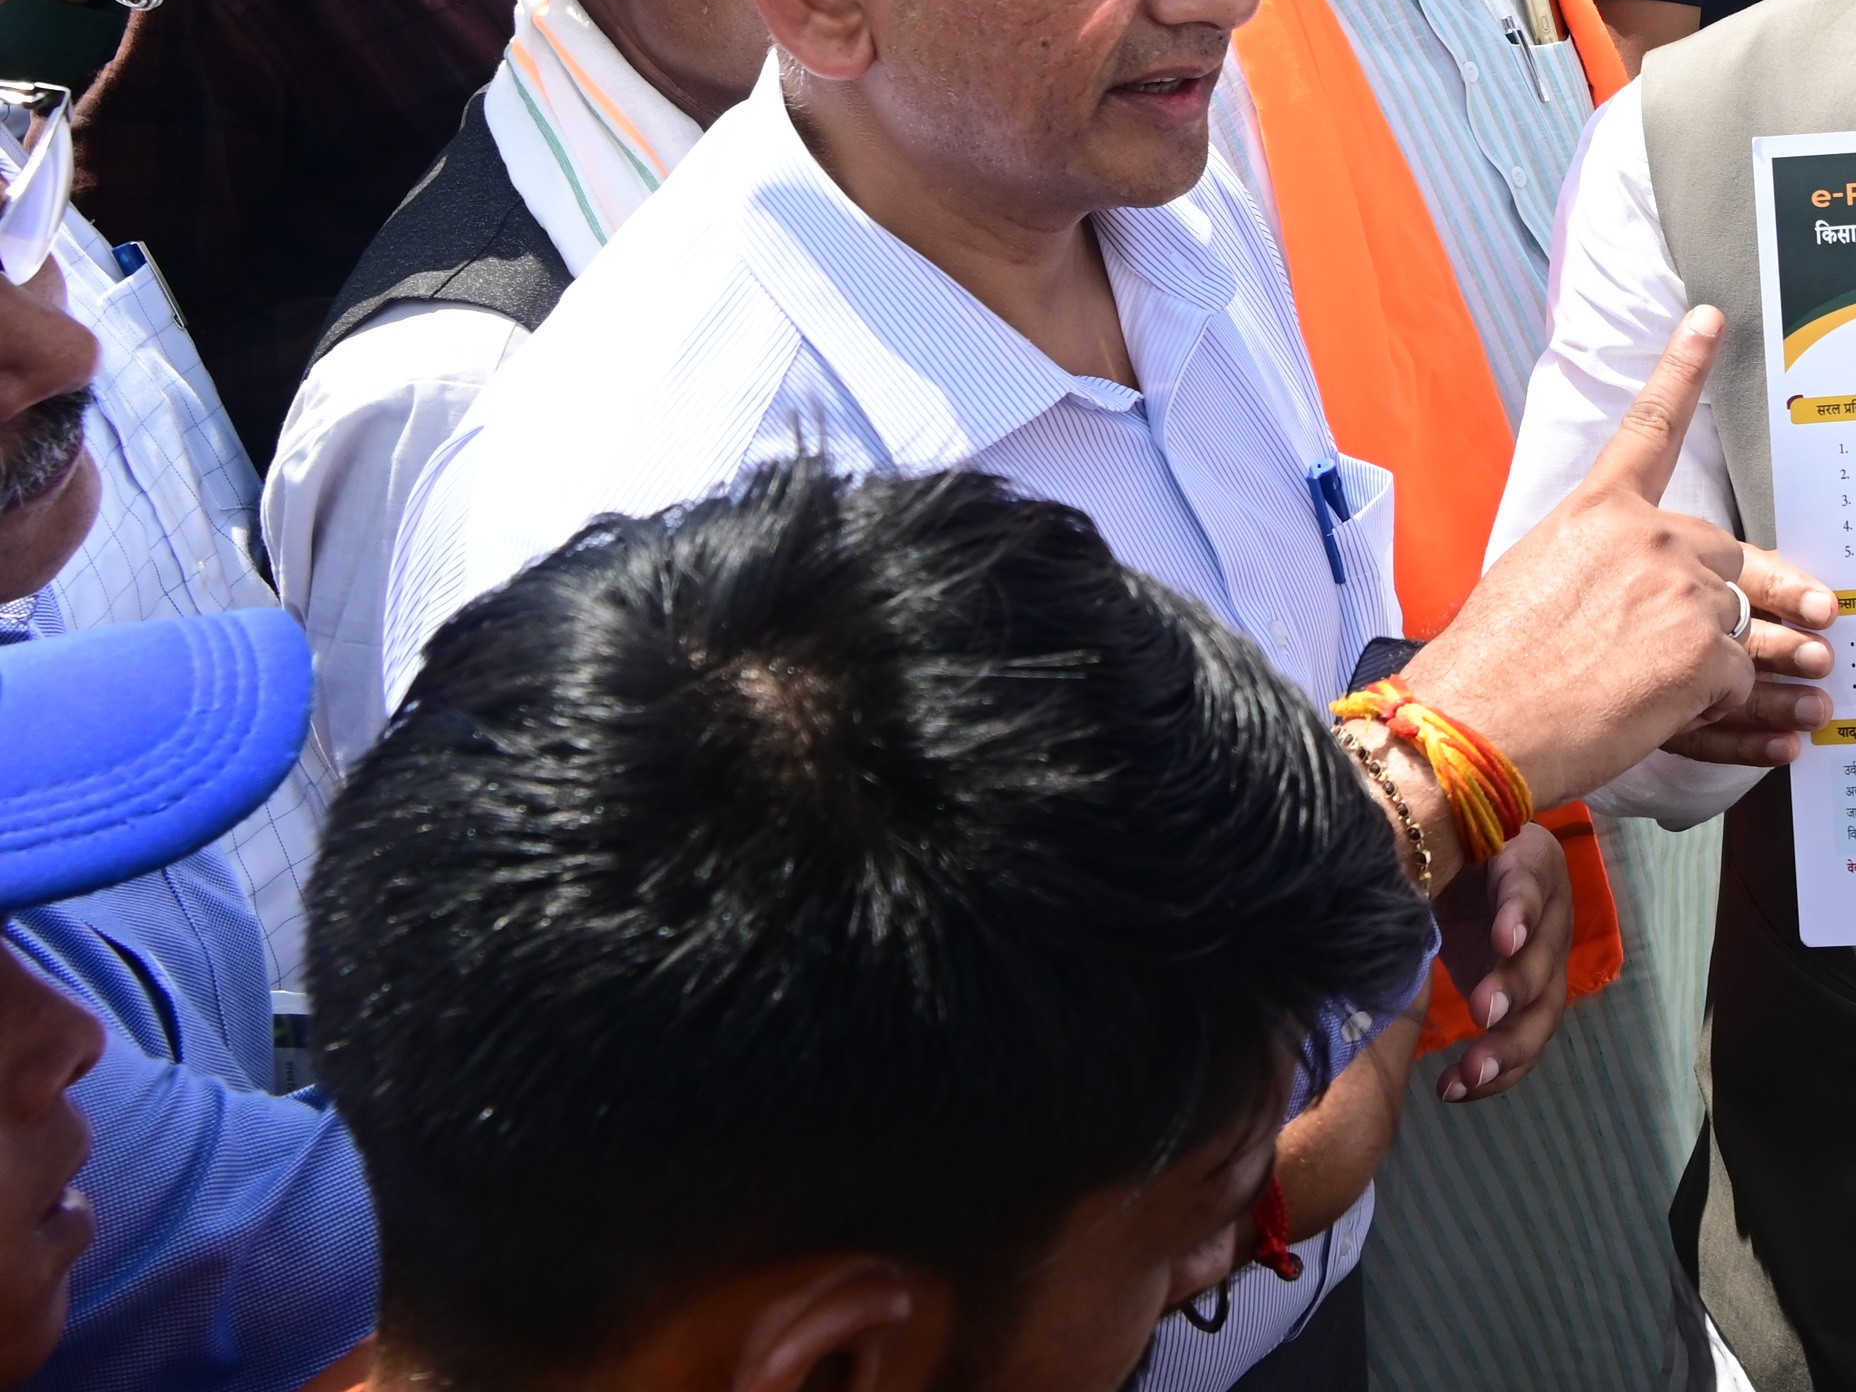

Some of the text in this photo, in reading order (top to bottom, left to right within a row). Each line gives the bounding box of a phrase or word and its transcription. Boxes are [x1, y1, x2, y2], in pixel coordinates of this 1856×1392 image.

[1816, 403, 1841, 416] सरल
[1839, 443, 1848, 454] 1.
[1839, 468, 1850, 480] 2.
[1841, 494, 1851, 507] 3.
[1842, 519, 1853, 532] 4.
[1844, 544, 1854, 558] 5.
[1836, 726, 1856, 740] याद
